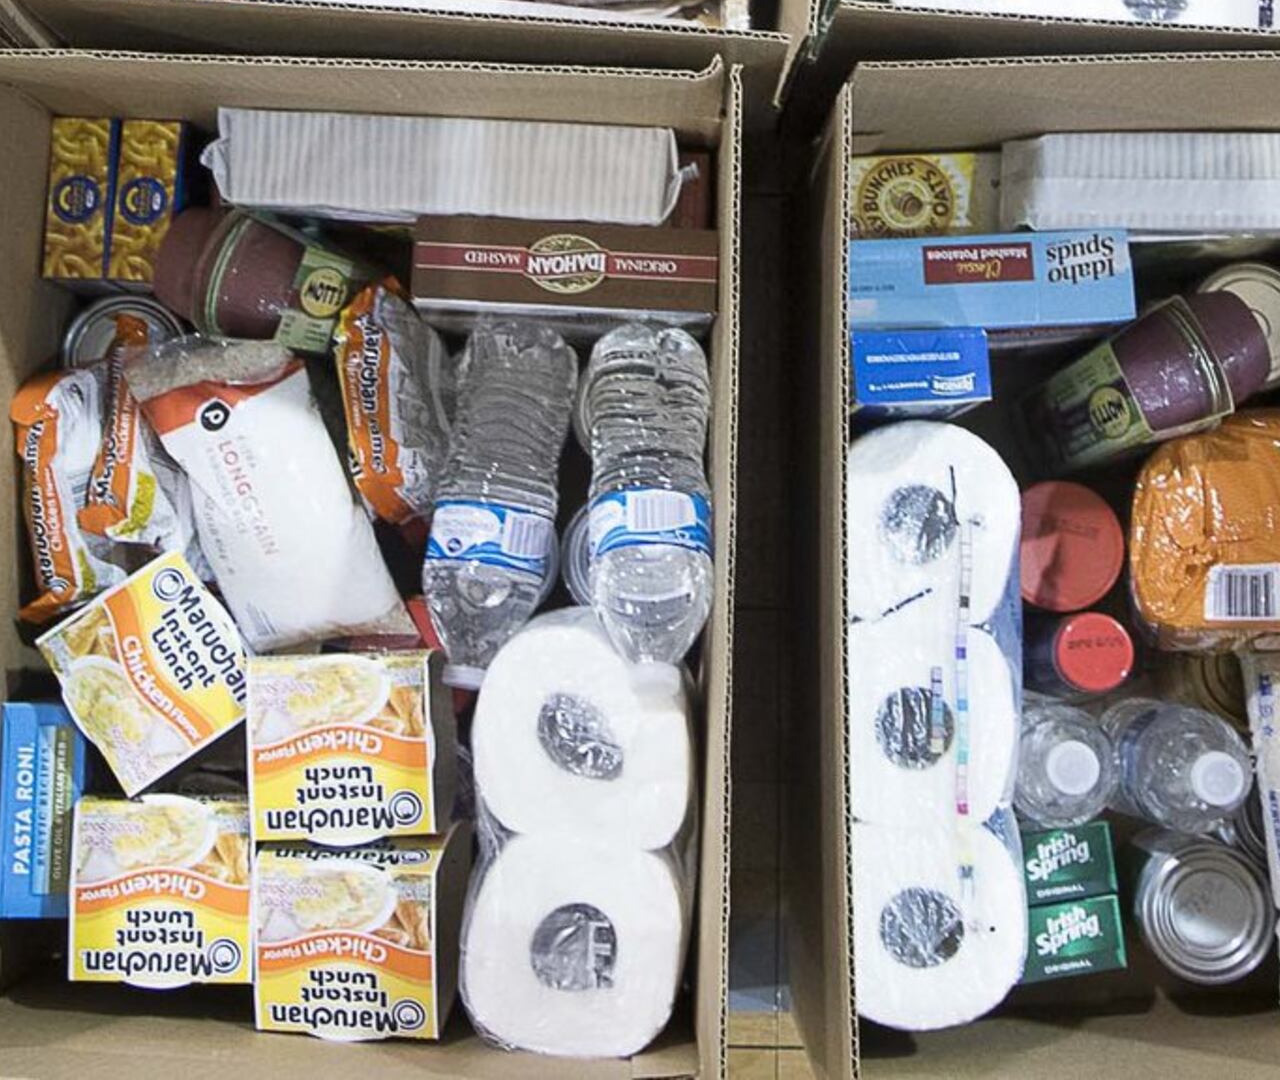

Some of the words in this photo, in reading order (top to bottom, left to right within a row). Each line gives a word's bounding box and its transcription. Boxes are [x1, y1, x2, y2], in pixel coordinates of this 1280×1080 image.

[864, 161, 916, 214] BUNCHES
[921, 169, 950, 217] OATS
[463, 251, 521, 264] MASHED
[926, 248, 979, 261] Potatoes
[980, 247, 1028, 259] Mashed
[1045, 234, 1114, 265] Spuds
[526, 252, 606, 275] IDAHOAN
[615, 257, 678, 274] ORIGINAL
[1047, 258, 1116, 284] Idaho
[219, 440, 252, 498] LONG
[161, 607, 218, 688] Instant
[179, 584, 247, 703] Maruchan
[151, 626, 195, 691] Lunch
[122, 635, 174, 712] Chicken
[296, 729, 383, 755] Chicken
[305, 766, 373, 785] Lunch
[296, 784, 383, 804] Instant
[267, 807, 395, 834] Maruchan
[12, 807, 32, 875] PASTA
[1036, 832, 1077, 860] Irish
[1026, 840, 1091, 881] Spring
[79, 884, 119, 901] Flavor
[121, 872, 207, 901] Chicken
[126, 909, 194, 927] Lunch
[1046, 905, 1087, 935] Irish
[116, 929, 203, 945] Instant
[1035, 913, 1100, 956] Spring
[262, 946, 300, 961] Flavor
[300, 934, 389, 963] Chicken
[84, 951, 212, 977] Maruchan
[309, 970, 377, 988] Lunch
[301, 987, 388, 1007] Instant
[271, 1004, 399, 1032] Maruchan
